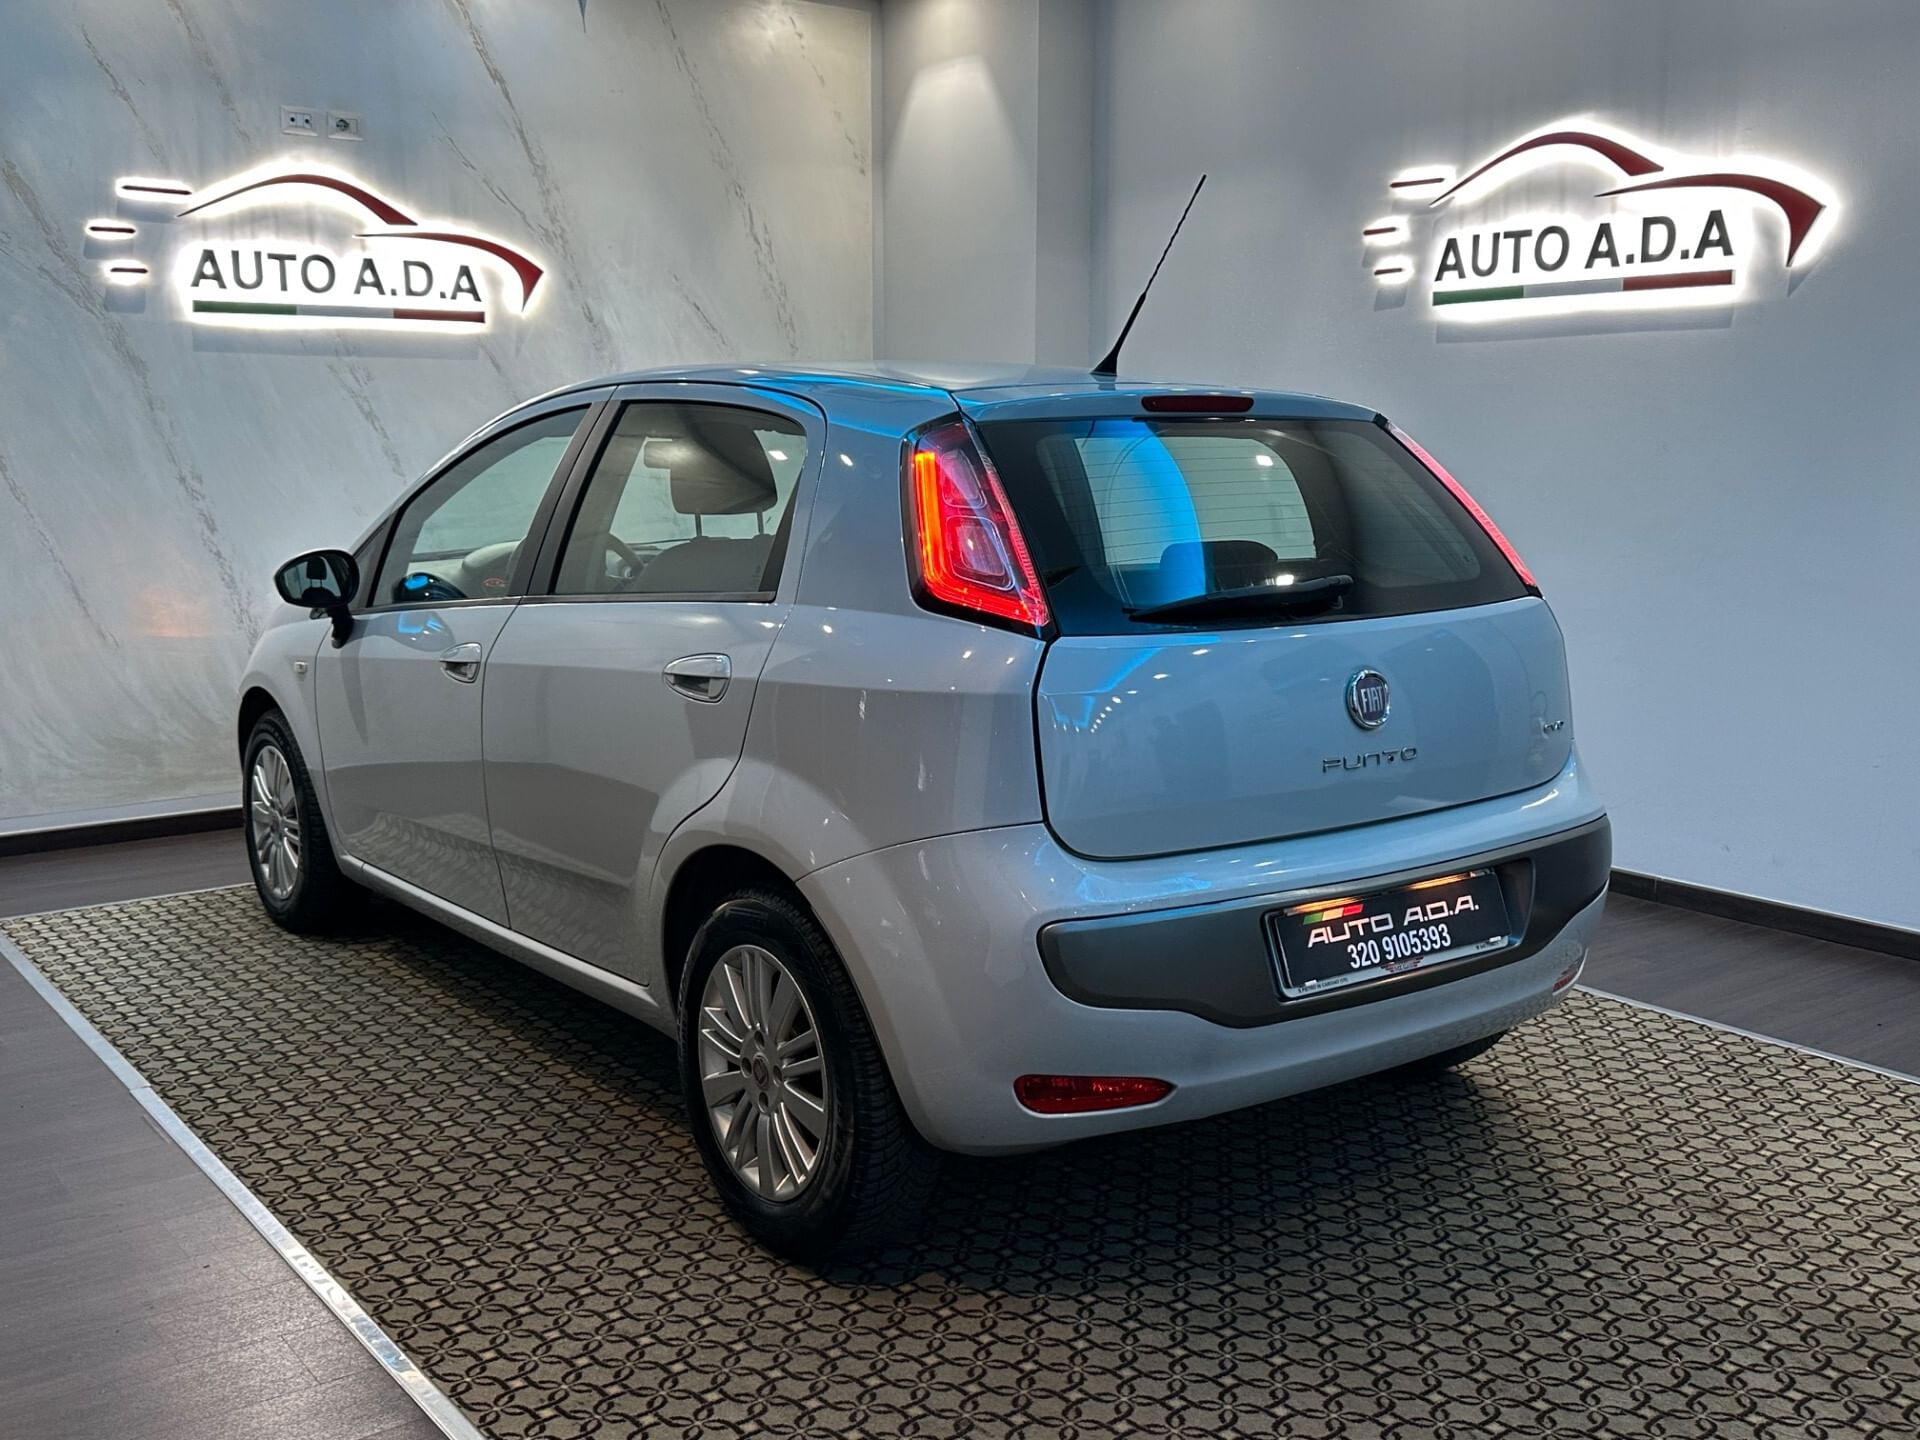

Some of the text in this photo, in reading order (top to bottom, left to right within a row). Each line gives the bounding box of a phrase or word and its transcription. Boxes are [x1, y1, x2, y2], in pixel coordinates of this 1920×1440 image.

[1434, 208, 1734, 282] AUTO A.D.A
[191, 248, 483, 303] AUTO A.D.A
[1360, 685, 1384, 713] FIAT
[1322, 746, 1417, 773] PUNTO
[1307, 894, 1480, 948] AUTO A.D.A.
[1347, 923, 1451, 969] 320 9105393
